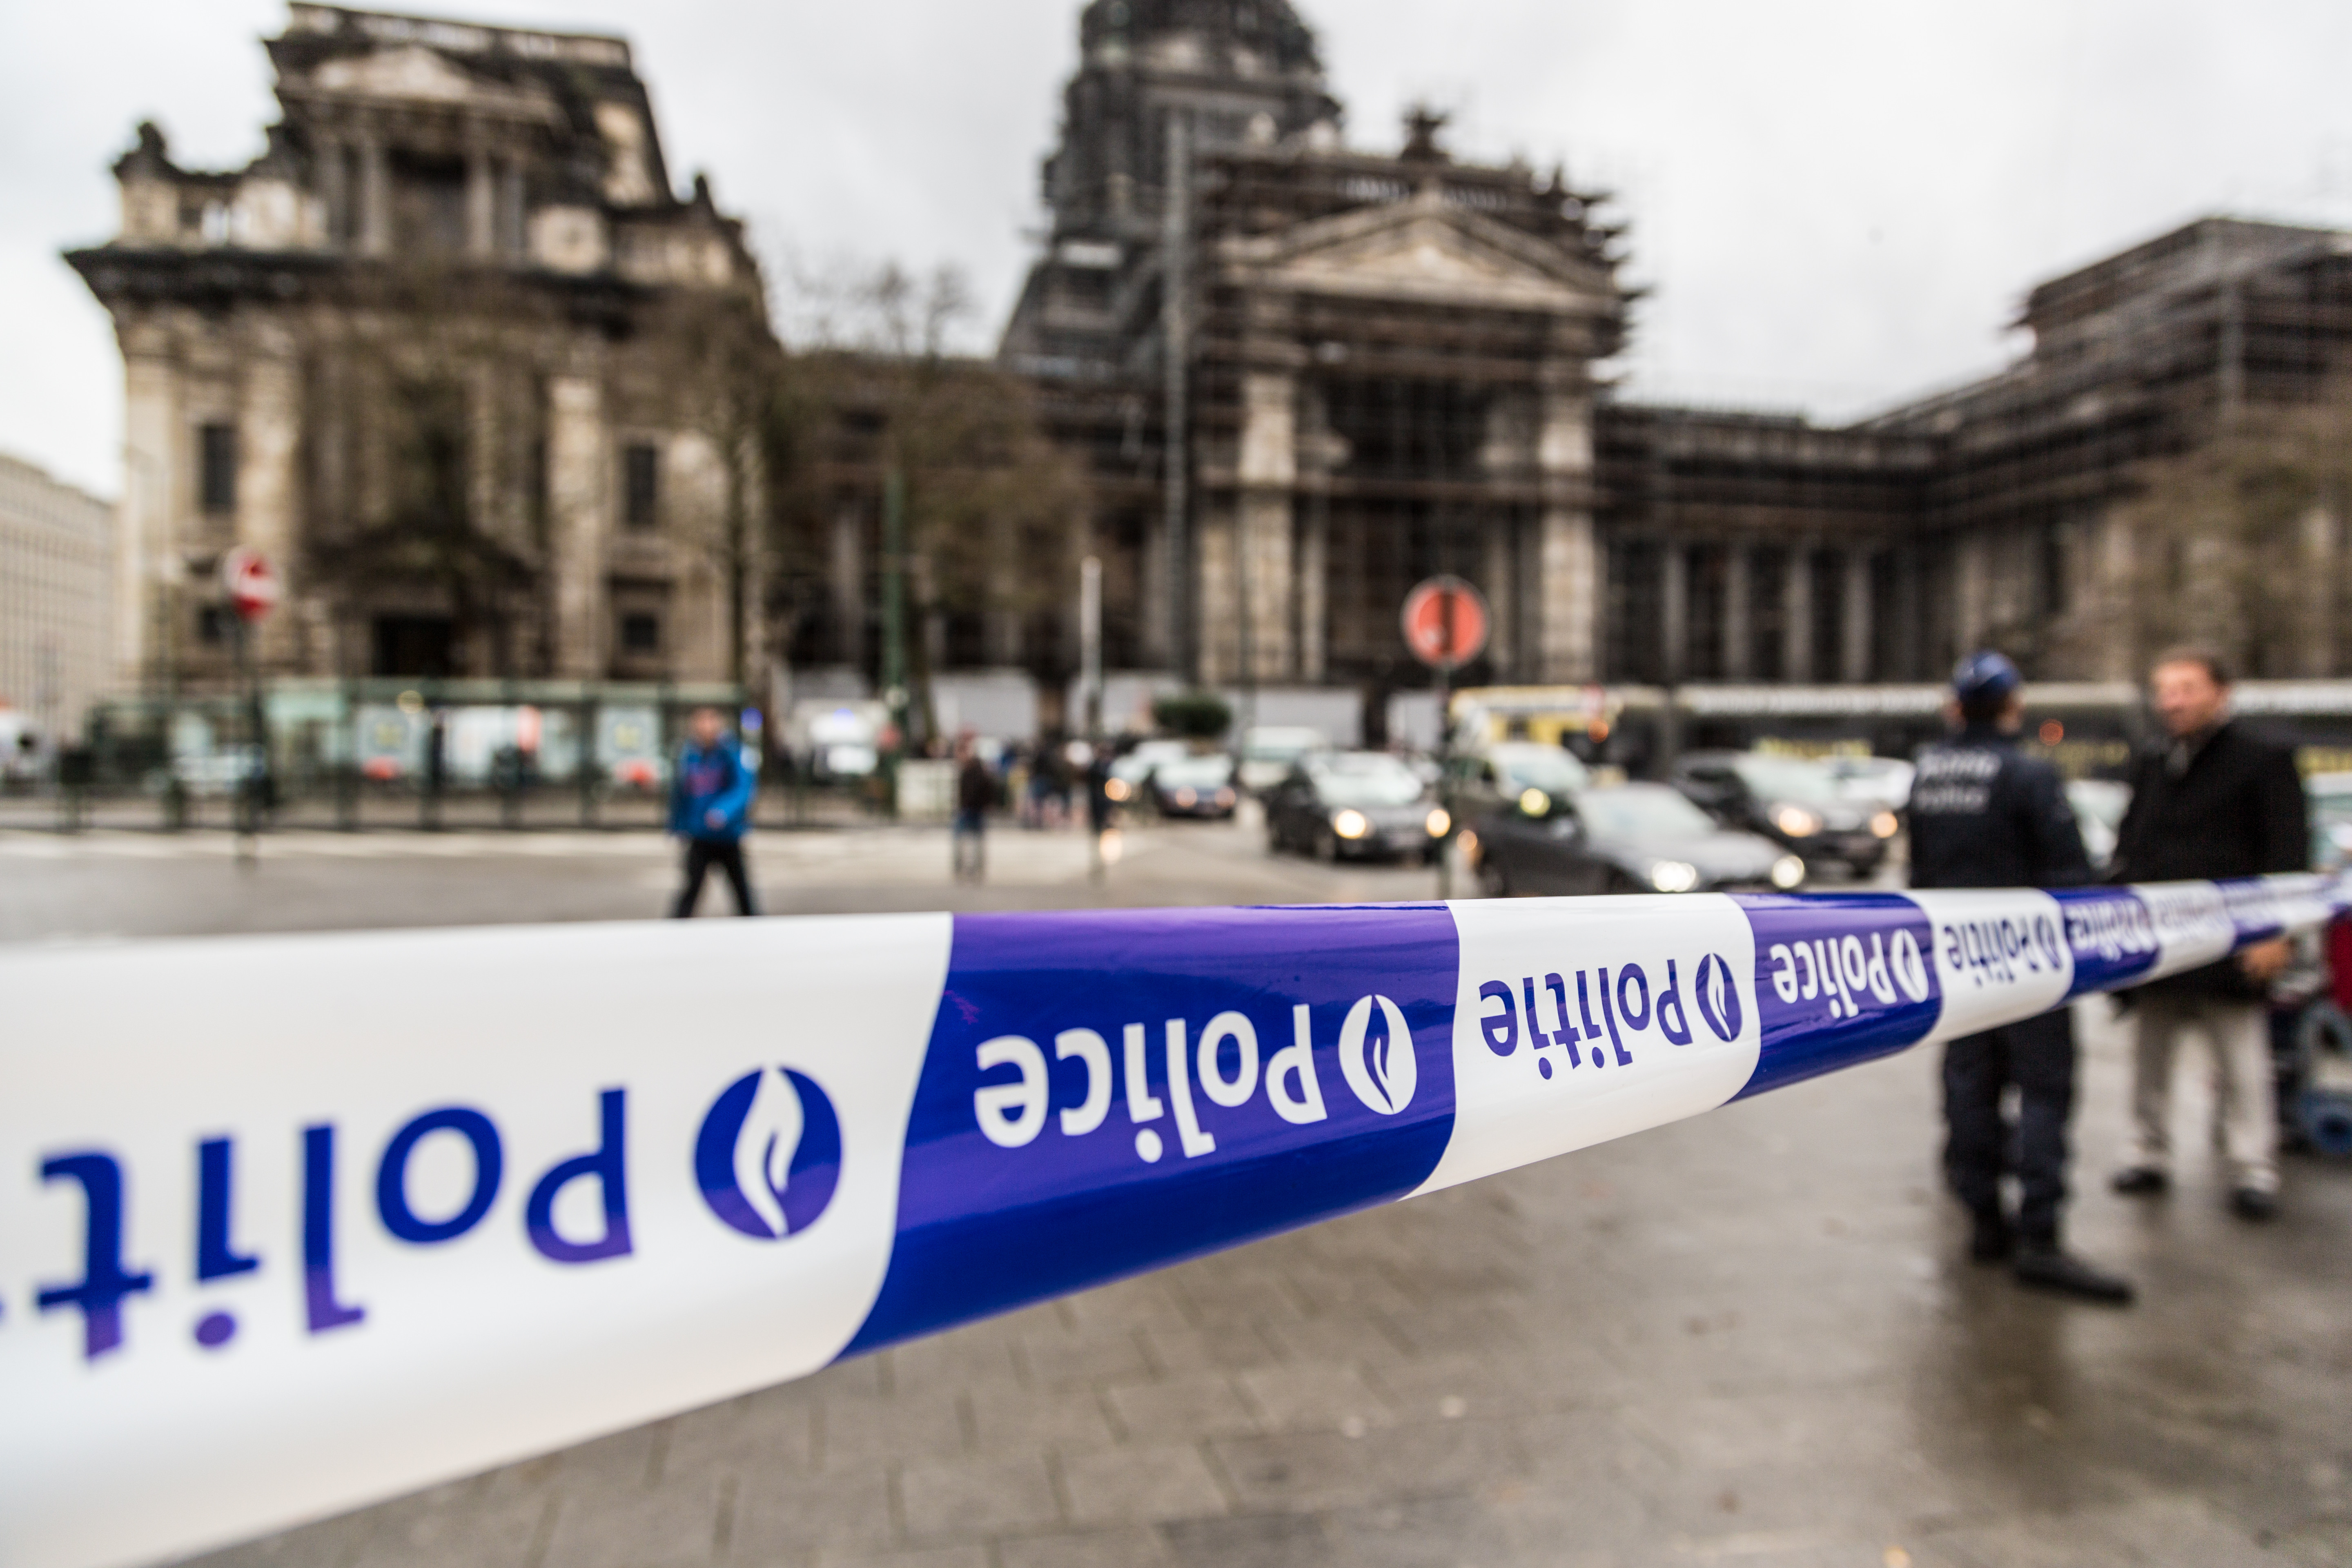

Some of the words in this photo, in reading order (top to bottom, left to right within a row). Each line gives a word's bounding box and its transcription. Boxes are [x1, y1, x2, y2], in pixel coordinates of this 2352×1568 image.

[1770, 932, 1898, 1018] Police
[1944, 918, 2038, 986] Politie
[1479, 958, 1693, 1080] Politie
[974, 1003, 1328, 1163] Police
[0, 1085, 635, 1362] Polit
